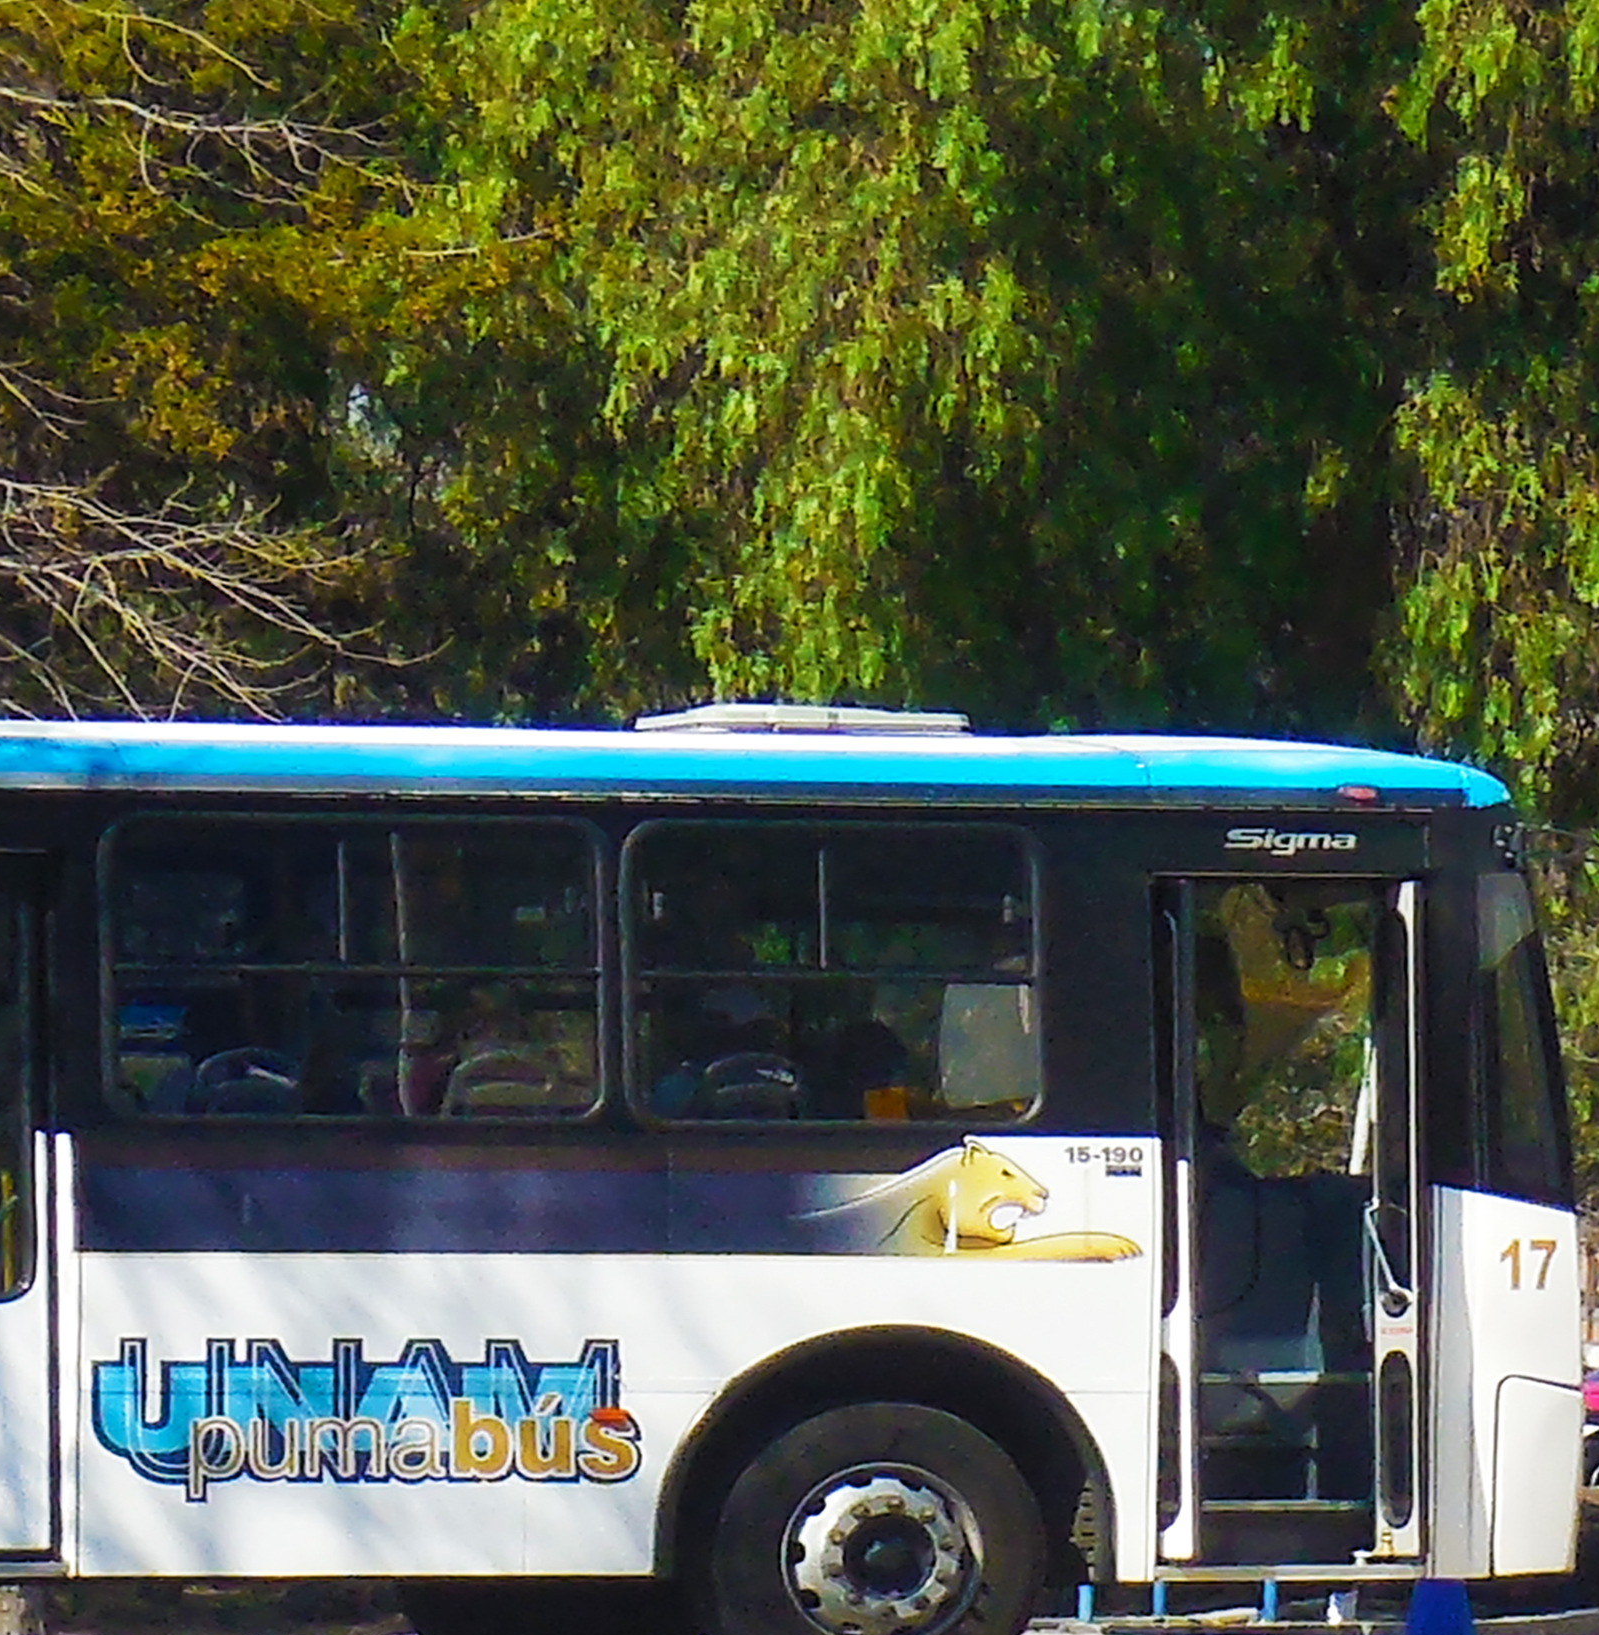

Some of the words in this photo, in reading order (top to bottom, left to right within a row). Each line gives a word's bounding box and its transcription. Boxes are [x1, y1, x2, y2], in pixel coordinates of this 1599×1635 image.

[1224, 828, 1358, 856] Sigma
[1064, 1146, 1144, 1164] 15-190
[1500, 1239, 1558, 1290] 17
[91, 1338, 620, 1483] UNAM
